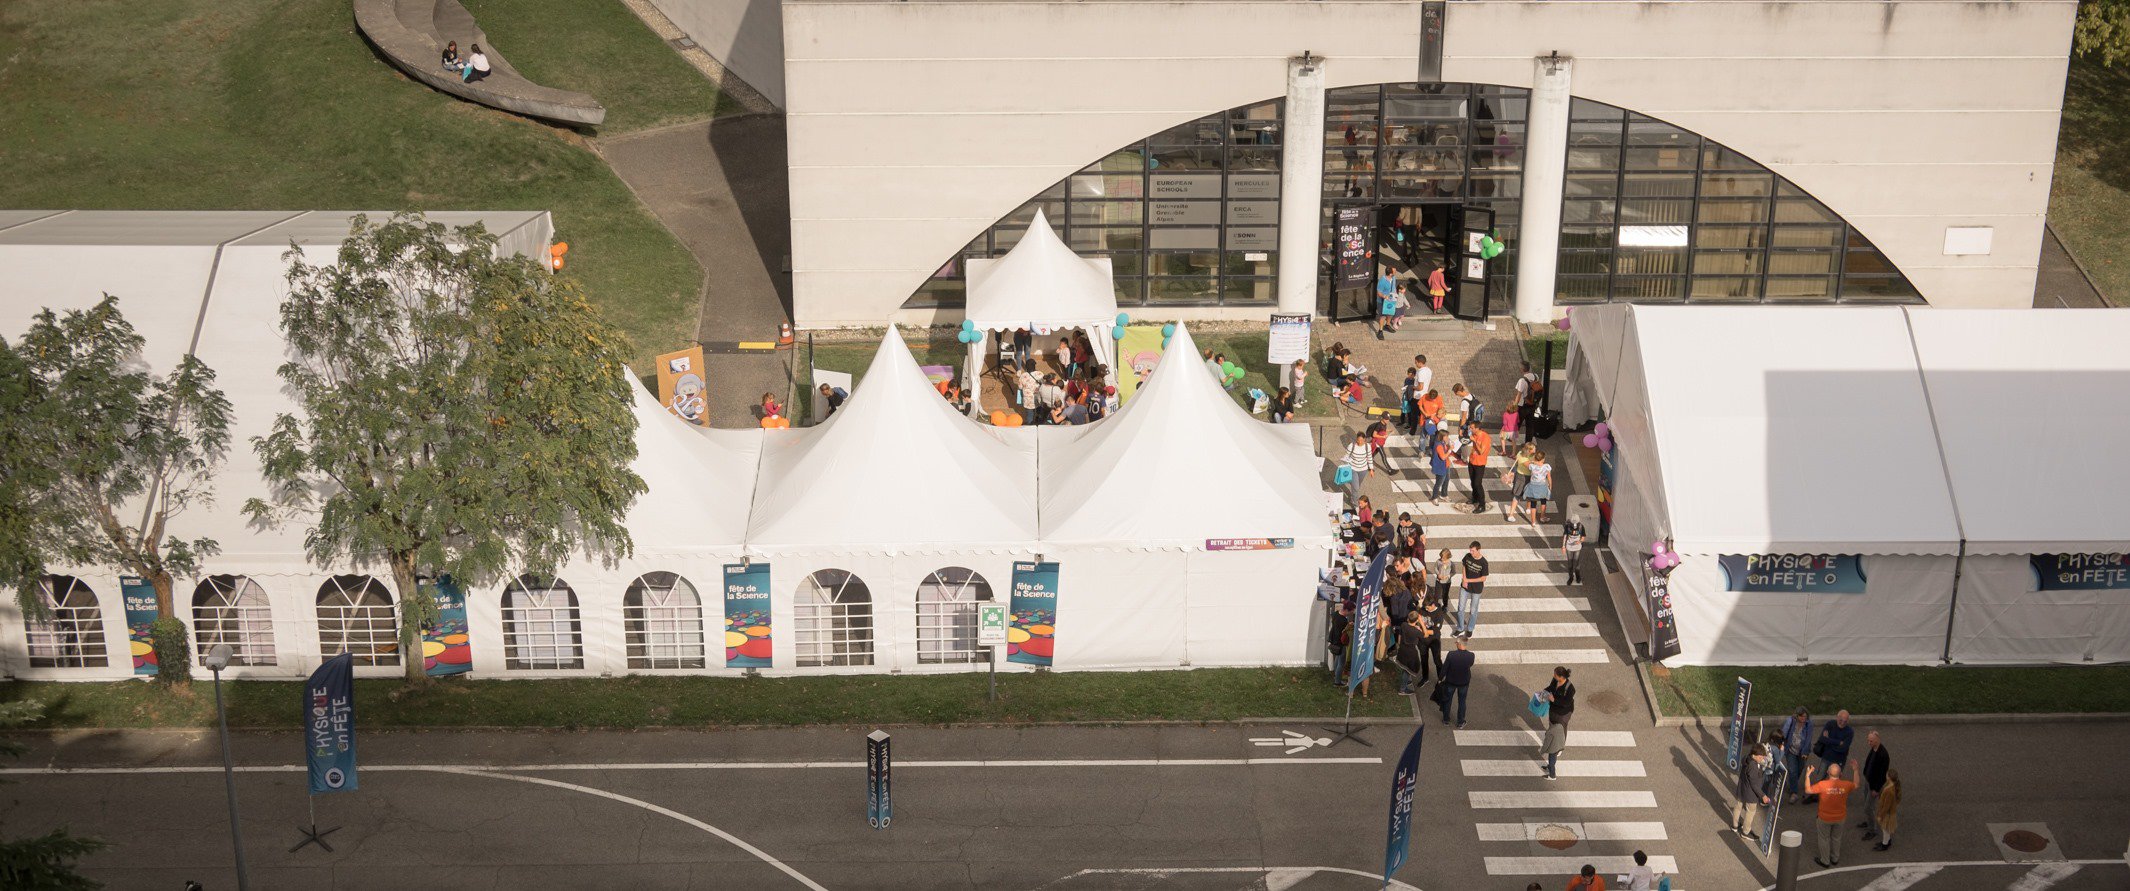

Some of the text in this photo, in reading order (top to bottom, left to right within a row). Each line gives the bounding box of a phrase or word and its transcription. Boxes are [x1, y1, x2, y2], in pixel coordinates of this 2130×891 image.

[1340, 225, 1359, 234] fête
[1340, 234, 1353, 242] de
[1342, 249, 1365, 258] ence
[1746, 555, 1837, 571] PHYSIQUE
[1747, 569, 1817, 590] en FÊTE
[2057, 566, 2128, 587] en FÊTE
[745, 584, 757, 592] de
[1016, 582, 1044, 591] fête de
[726, 592, 769, 600] la Science
[1022, 590, 1056, 599] Science
[1651, 588, 1665, 598] de
[127, 596, 156, 604] fête de
[439, 595, 450, 603] de
[135, 603, 159, 611] Scien
[313, 686, 334, 757] PHYSIQUE
[330, 696, 352, 753] en FÊTE
